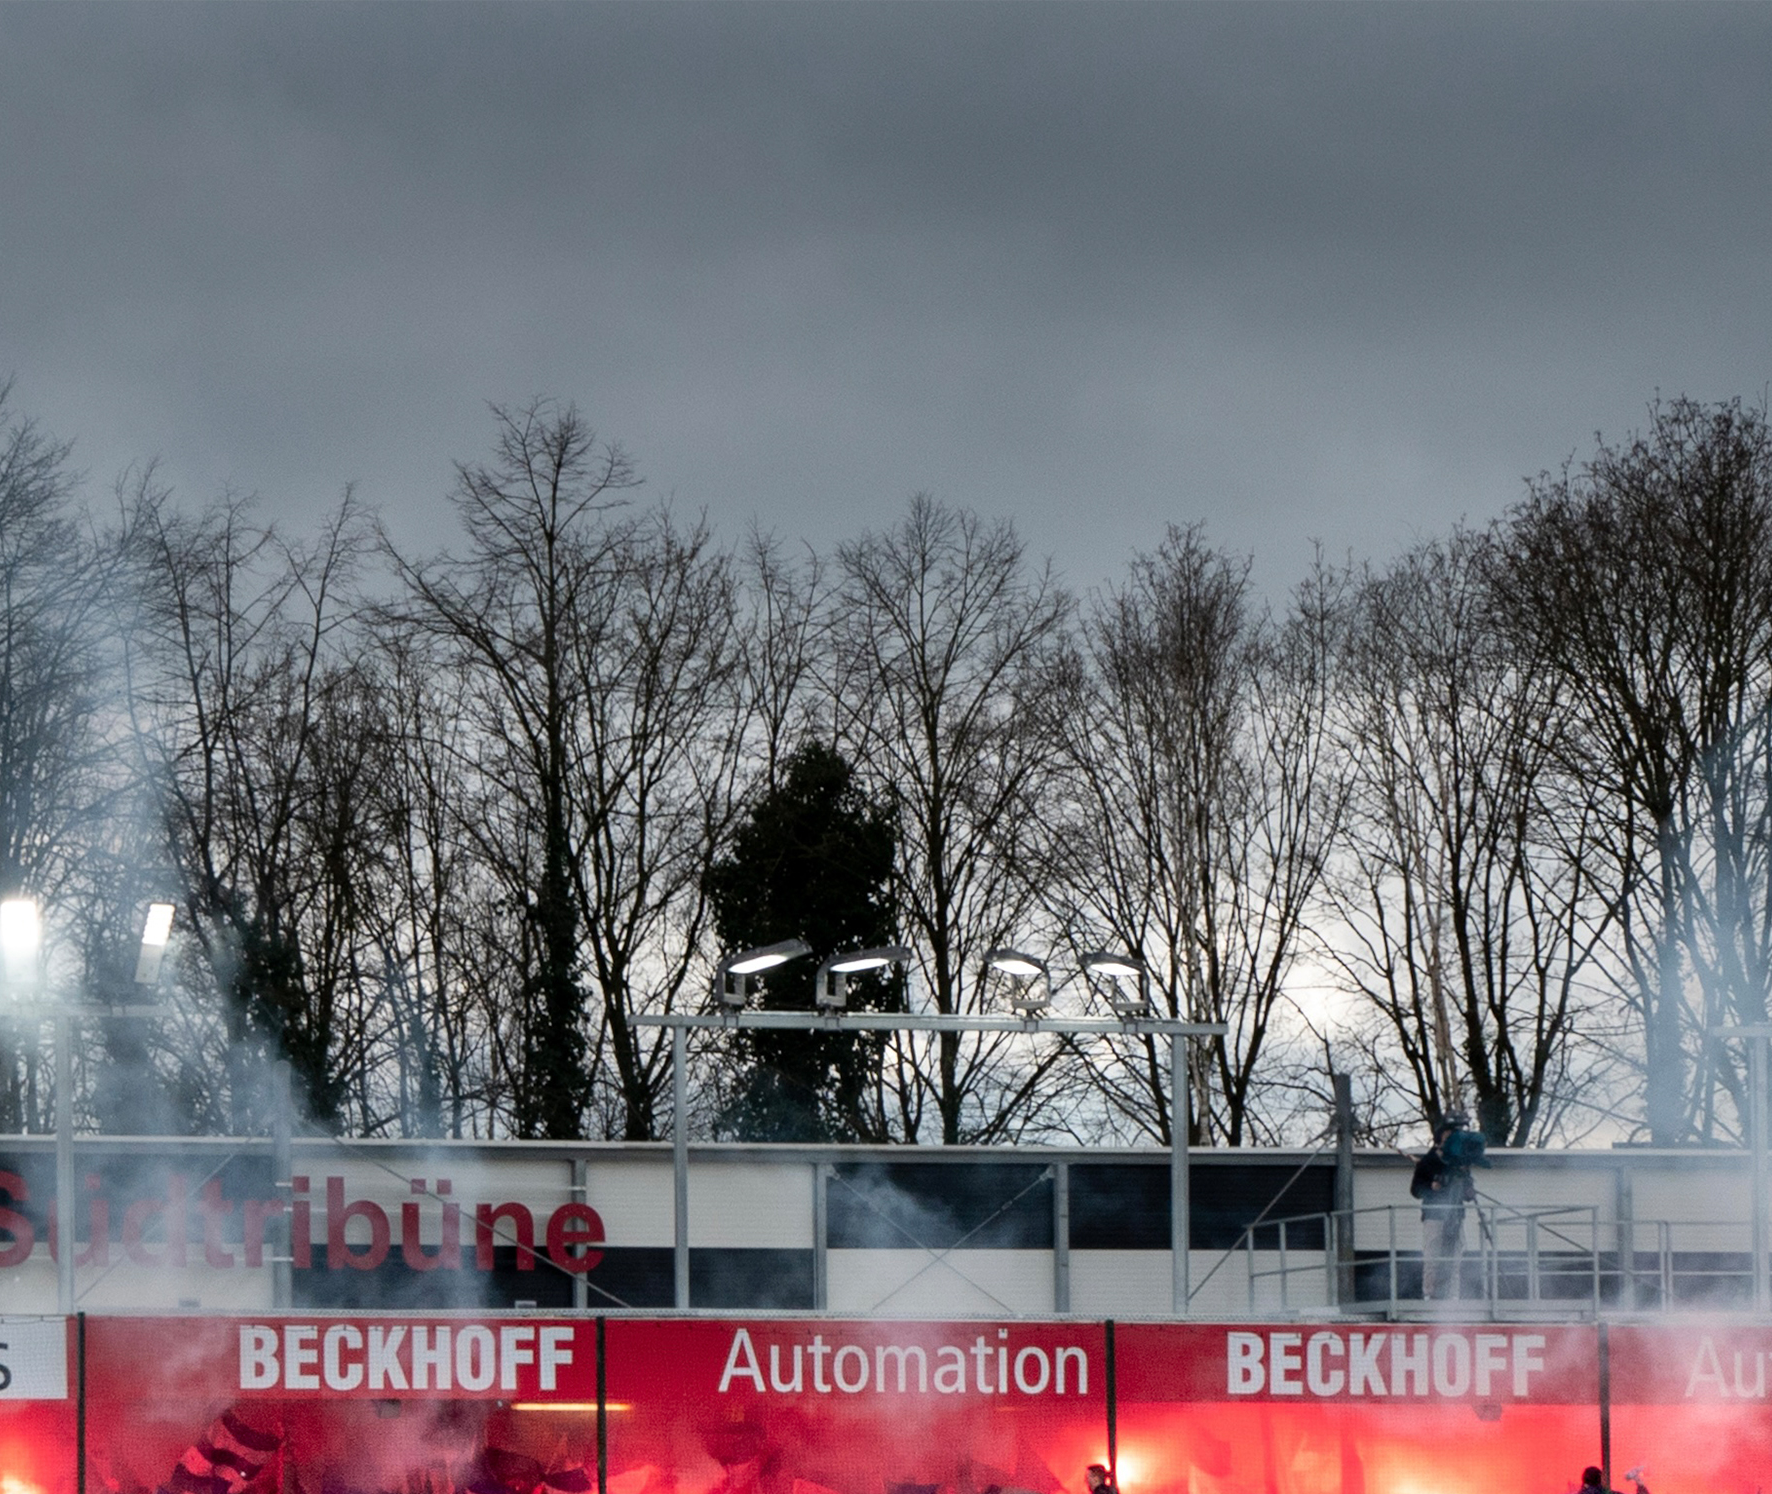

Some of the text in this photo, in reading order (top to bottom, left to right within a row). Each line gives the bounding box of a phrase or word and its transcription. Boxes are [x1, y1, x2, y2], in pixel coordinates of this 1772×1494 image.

[239, 1324, 575, 1392] BECKHOFF
[718, 1329, 1089, 1394] Automation
[1228, 1332, 1547, 1397] BECKHOFF
